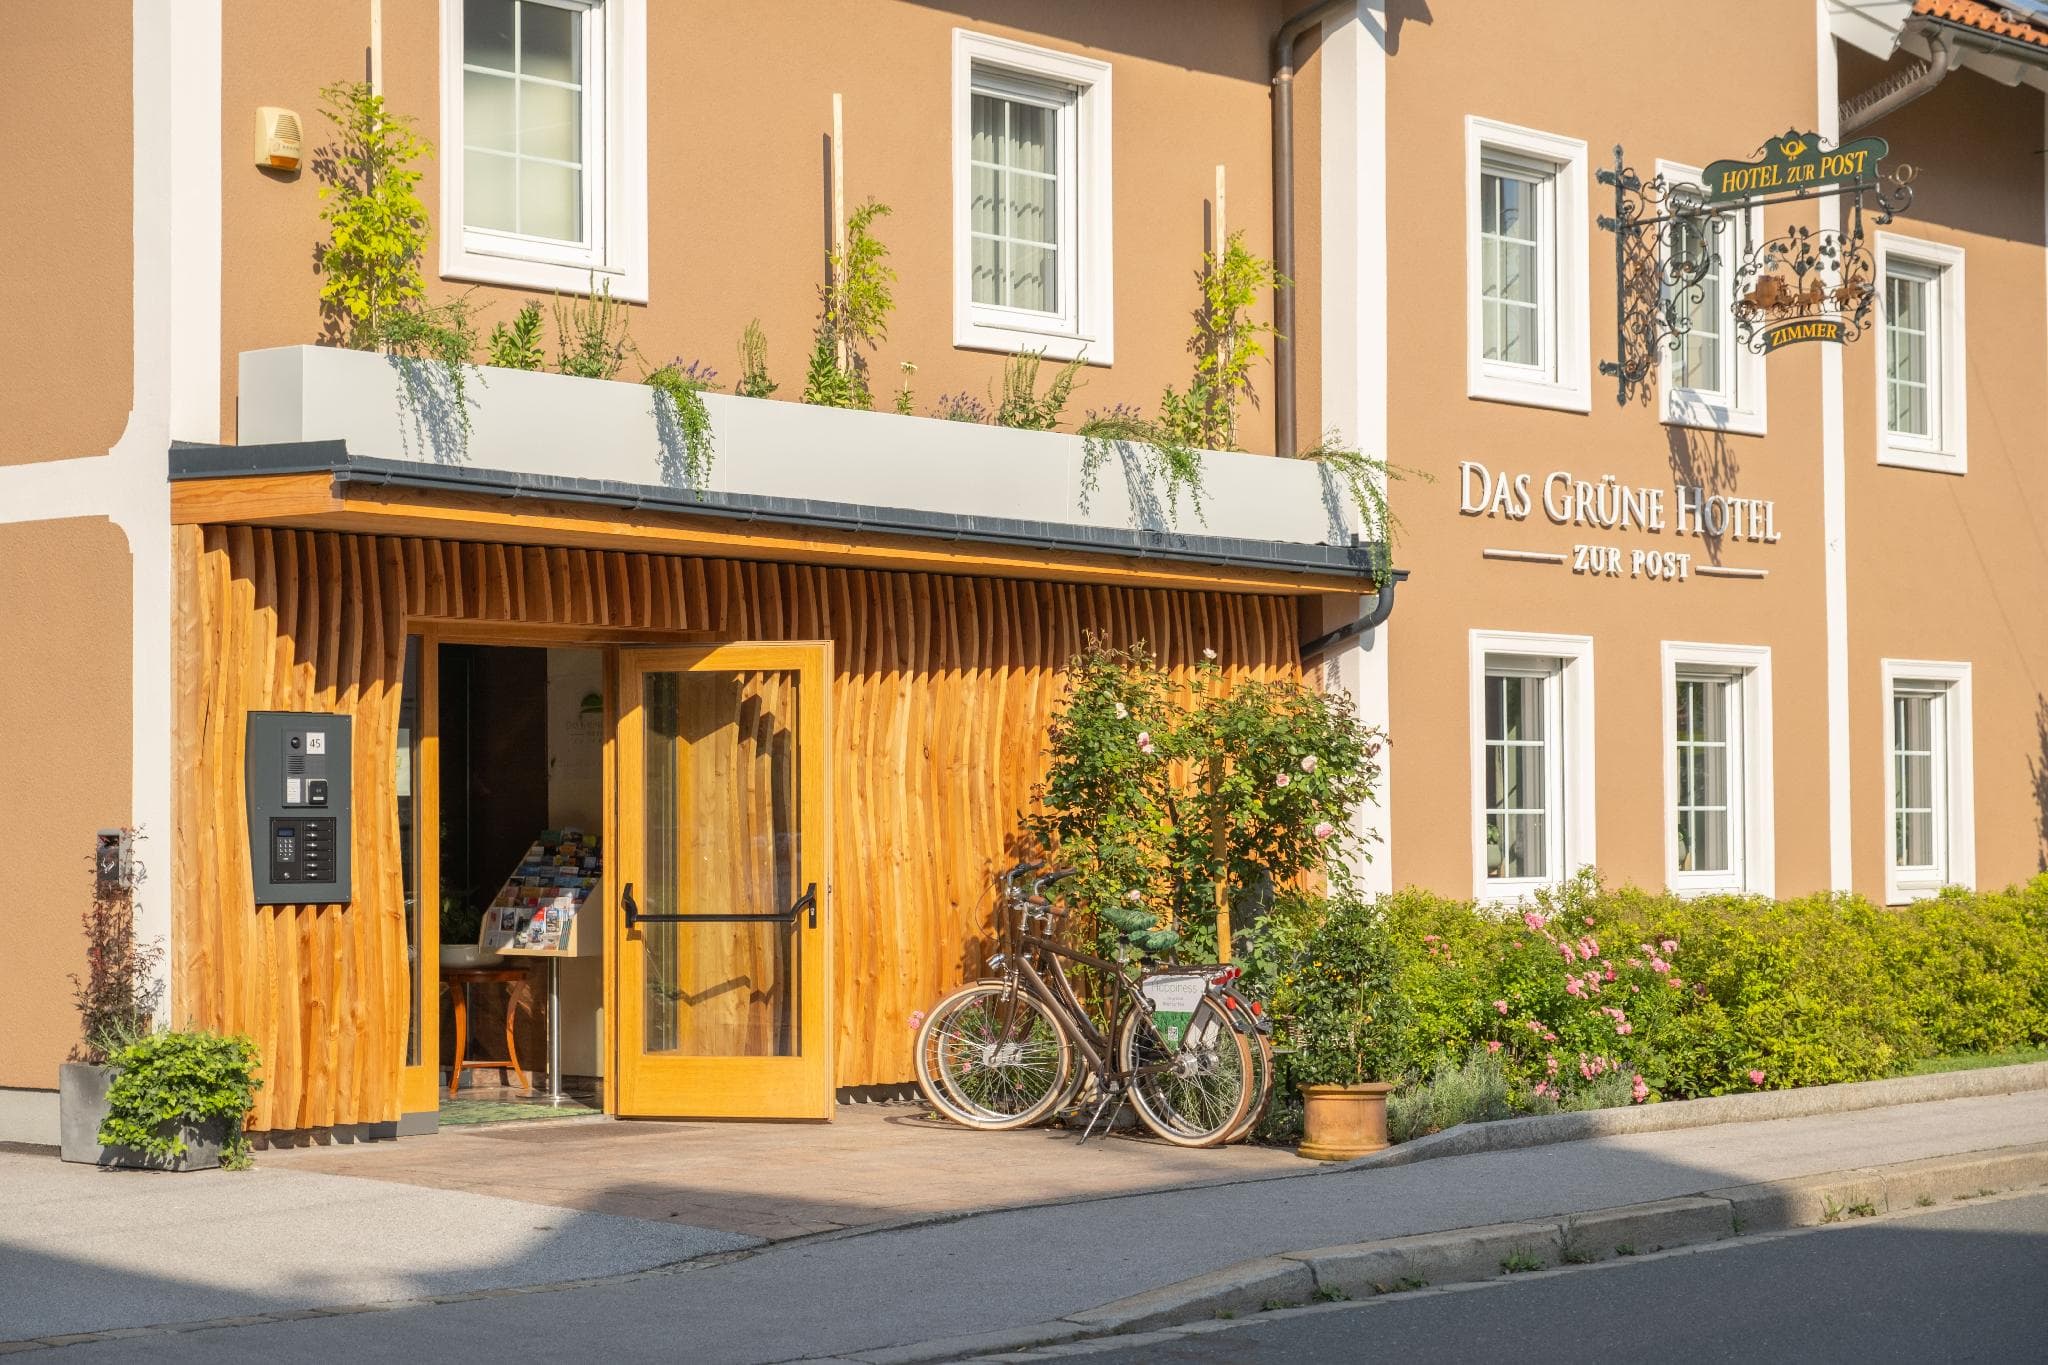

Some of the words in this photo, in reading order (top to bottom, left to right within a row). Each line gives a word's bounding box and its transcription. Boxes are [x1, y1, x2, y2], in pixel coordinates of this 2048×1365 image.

[1721, 164, 1783, 193] HOTEL
[1786, 164, 1815, 183] ZUR
[1820, 150, 1869, 180] POST
[1769, 322, 1838, 347] ZIMMER
[1458, 460, 1532, 517] DAS
[1543, 471, 1665, 529] GRÜNE
[1675, 484, 1781, 541] HOTEL
[1572, 544, 1623, 574] ZUR
[1630, 549, 1691, 579] POST
[309, 739, 321, 748] 45
